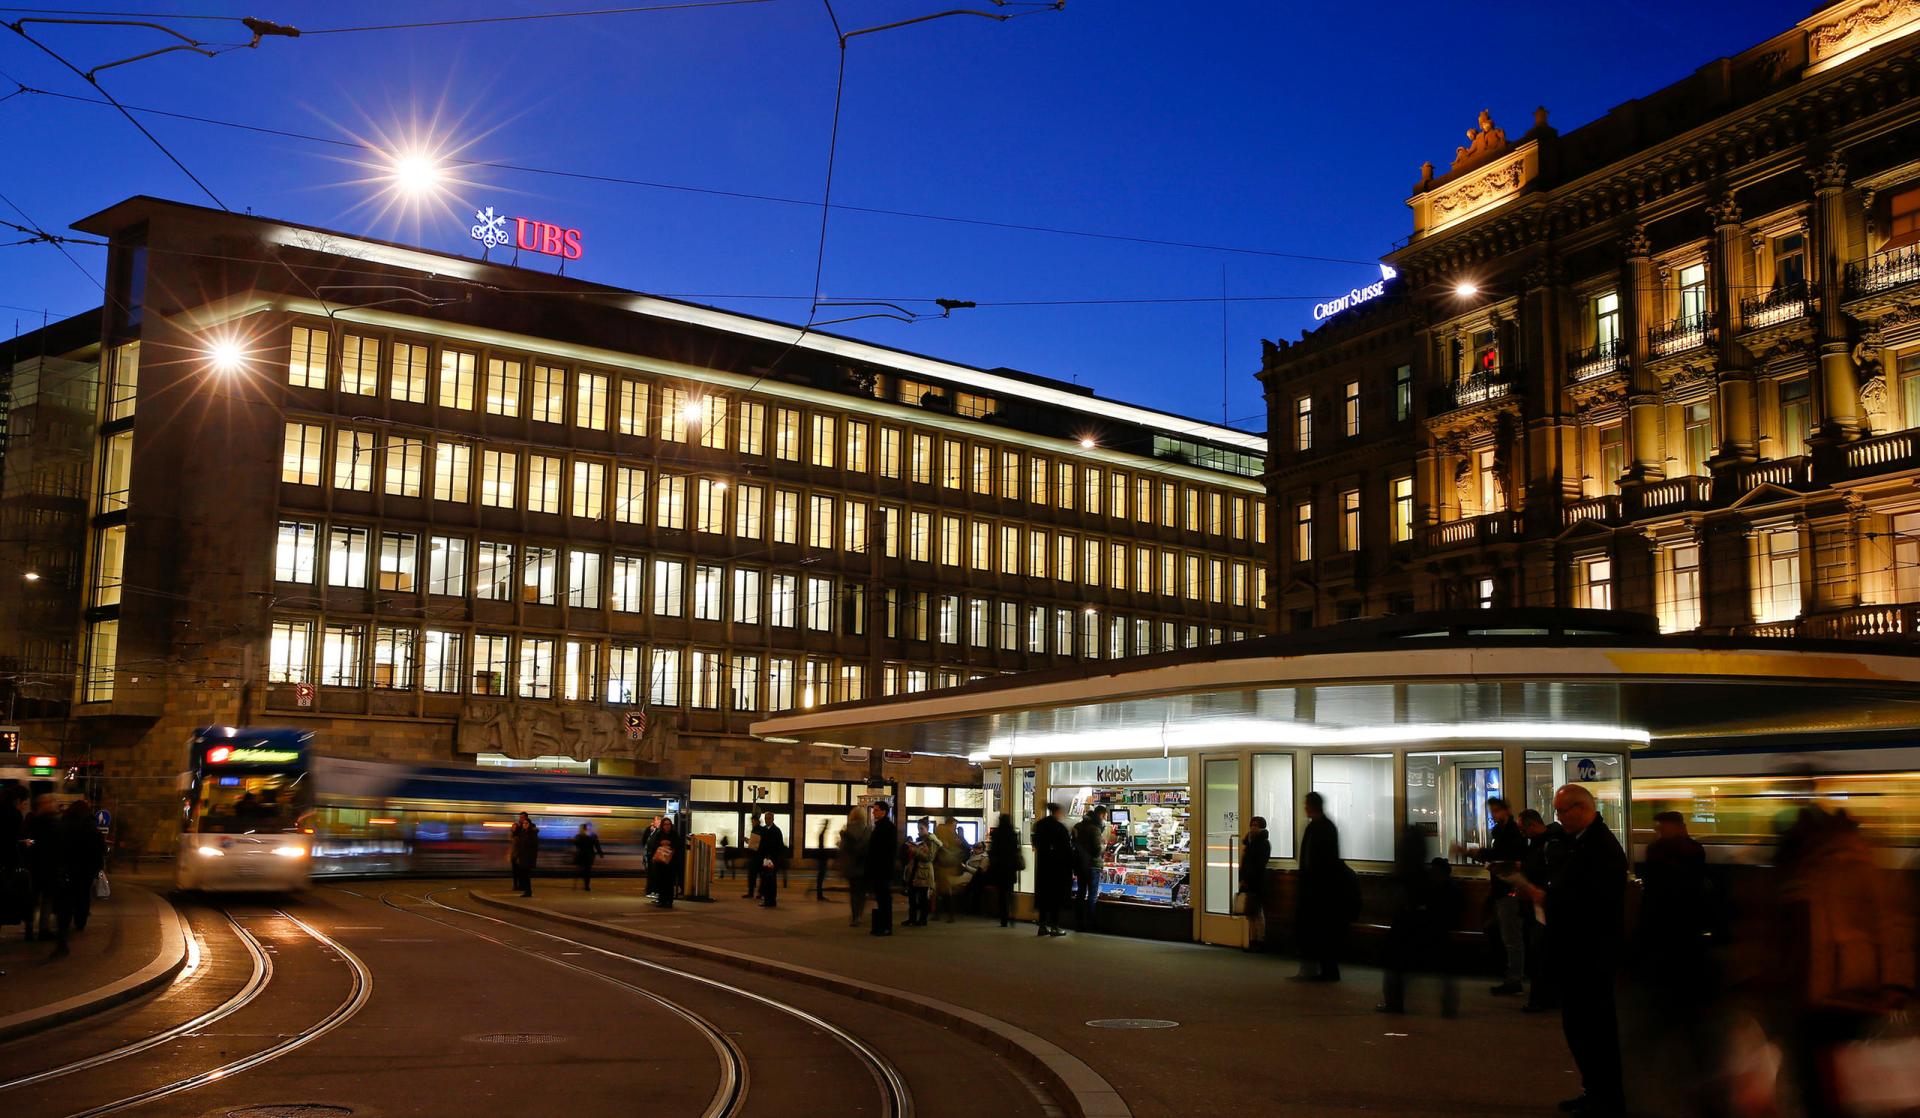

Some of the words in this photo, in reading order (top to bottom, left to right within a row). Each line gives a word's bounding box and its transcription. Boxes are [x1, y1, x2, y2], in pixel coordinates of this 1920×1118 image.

[516, 217, 583, 260] UBS
[1097, 765, 1104, 782] k
[1104, 764, 1133, 782] kiosk
[1579, 767, 1597, 779] WC
